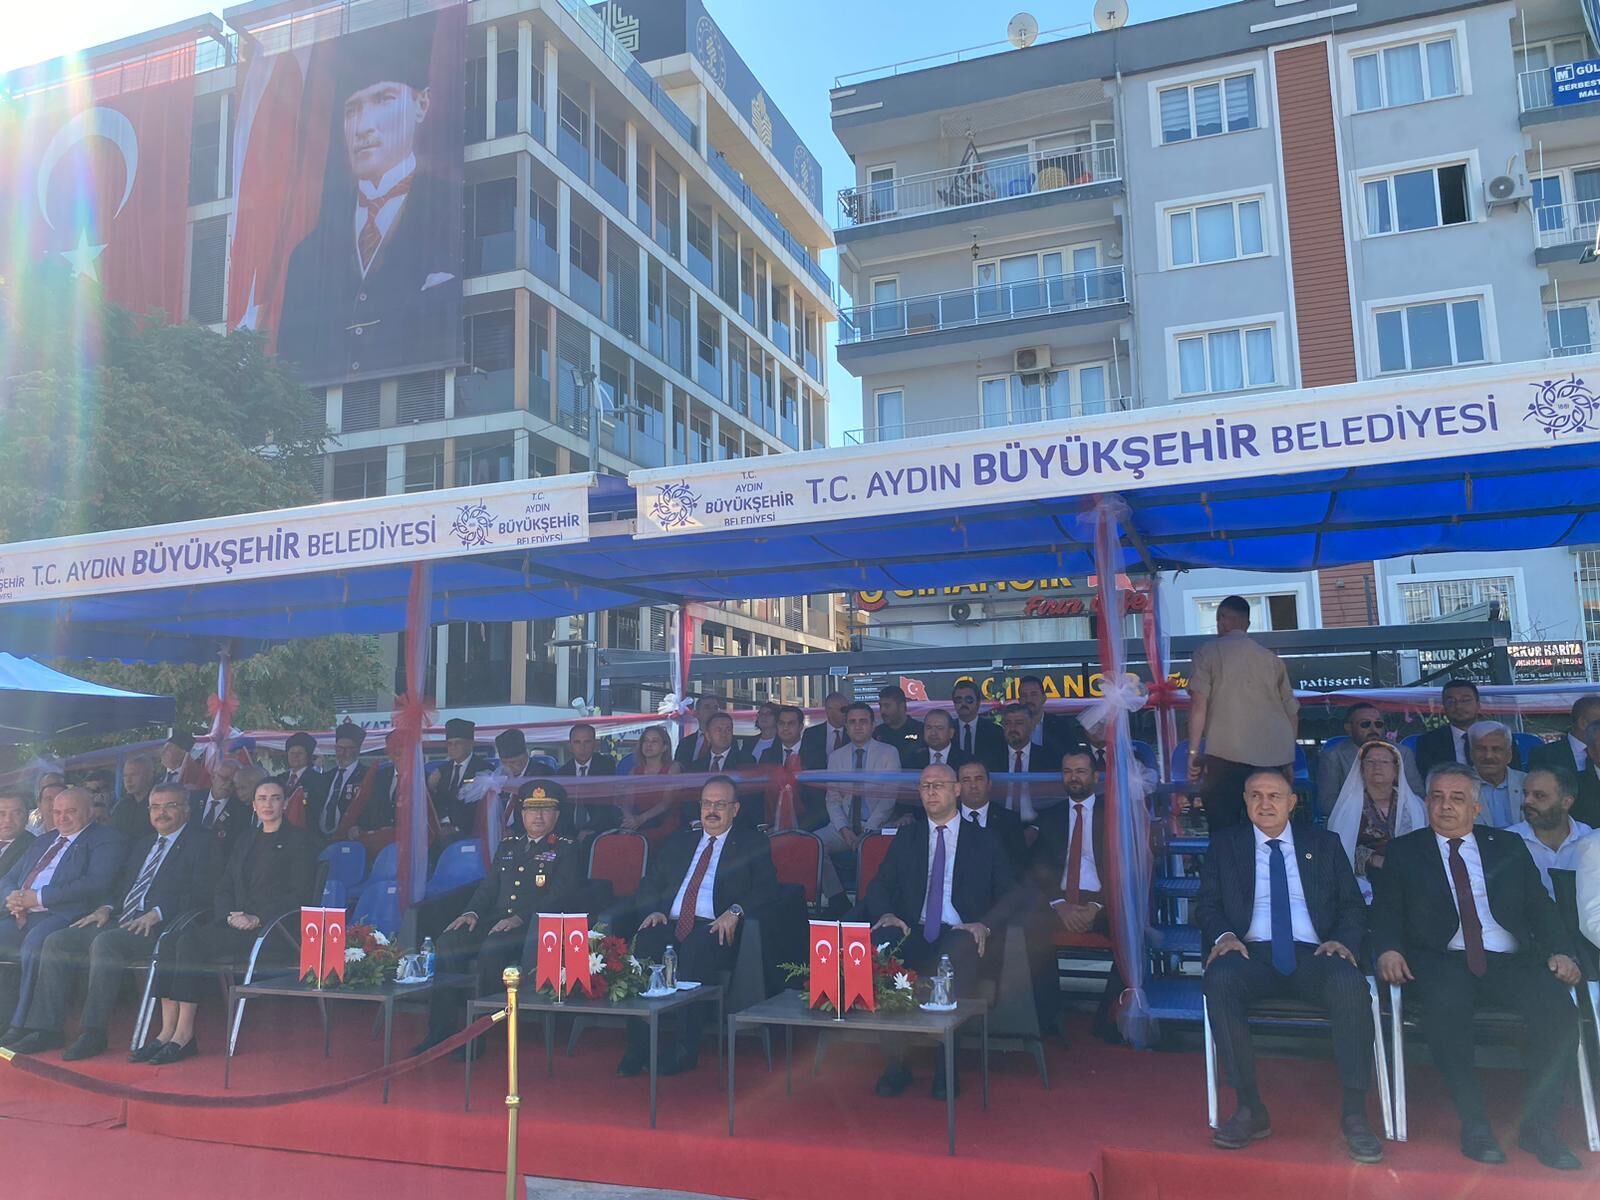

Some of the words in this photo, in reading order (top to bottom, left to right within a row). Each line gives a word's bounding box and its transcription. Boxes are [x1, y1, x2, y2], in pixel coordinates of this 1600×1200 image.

[806, 476, 856, 504] T.C.
[866, 463, 961, 498] AYDIN
[973, 418, 1260, 486] BÜYÜKŞEHİR
[1271, 394, 1498, 454] BELEDİYESİ
[741, 471, 757, 480] T.C.
[735, 482, 763, 493] AYDIN
[525, 503, 550, 514] AYDIN
[705, 491, 794, 514] BÜYÜKŞEHİR
[498, 512, 580, 535] BÜYÜKŞEHİR
[724, 512, 776, 527] BELEDİYESİ
[31, 563, 61, 586] T.C.
[66, 556, 126, 583] AYDIN
[131, 527, 300, 575] BÜYÜKŞEHİR
[307, 514, 437, 557] BELEDİYESİ
[1419, 649, 1456, 662] ERKUR
[1543, 641, 1582, 657] HARİTA
[1299, 675, 1370, 690] patisserie
